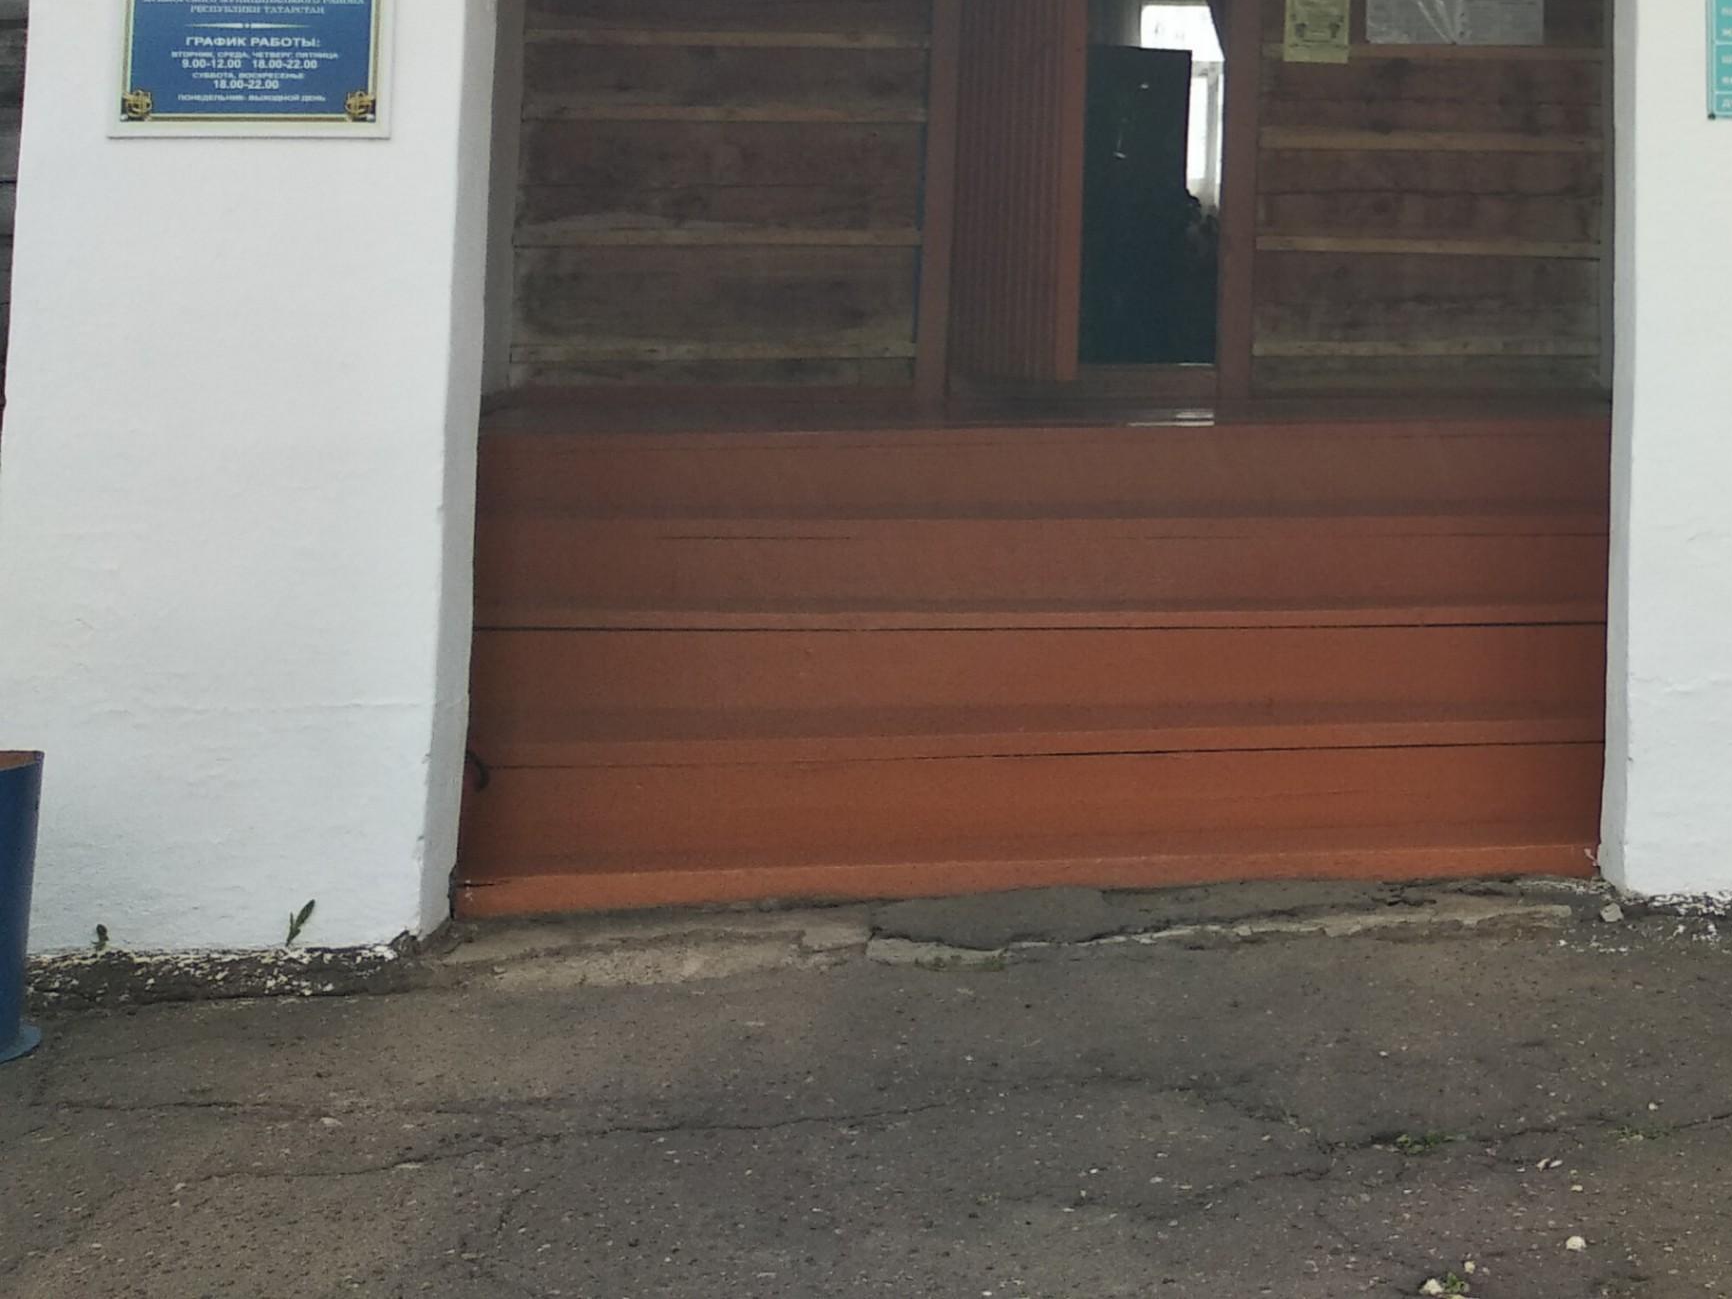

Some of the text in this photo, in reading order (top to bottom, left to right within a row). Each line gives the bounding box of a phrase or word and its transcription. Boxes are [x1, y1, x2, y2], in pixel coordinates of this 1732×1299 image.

[186, 36, 321, 48] ГРАФИК РАБОТЫ:
[182, 59, 319, 70] 9.00-12.00 18.00-22.00
[213, 79, 280, 89] 18.00-22.00
